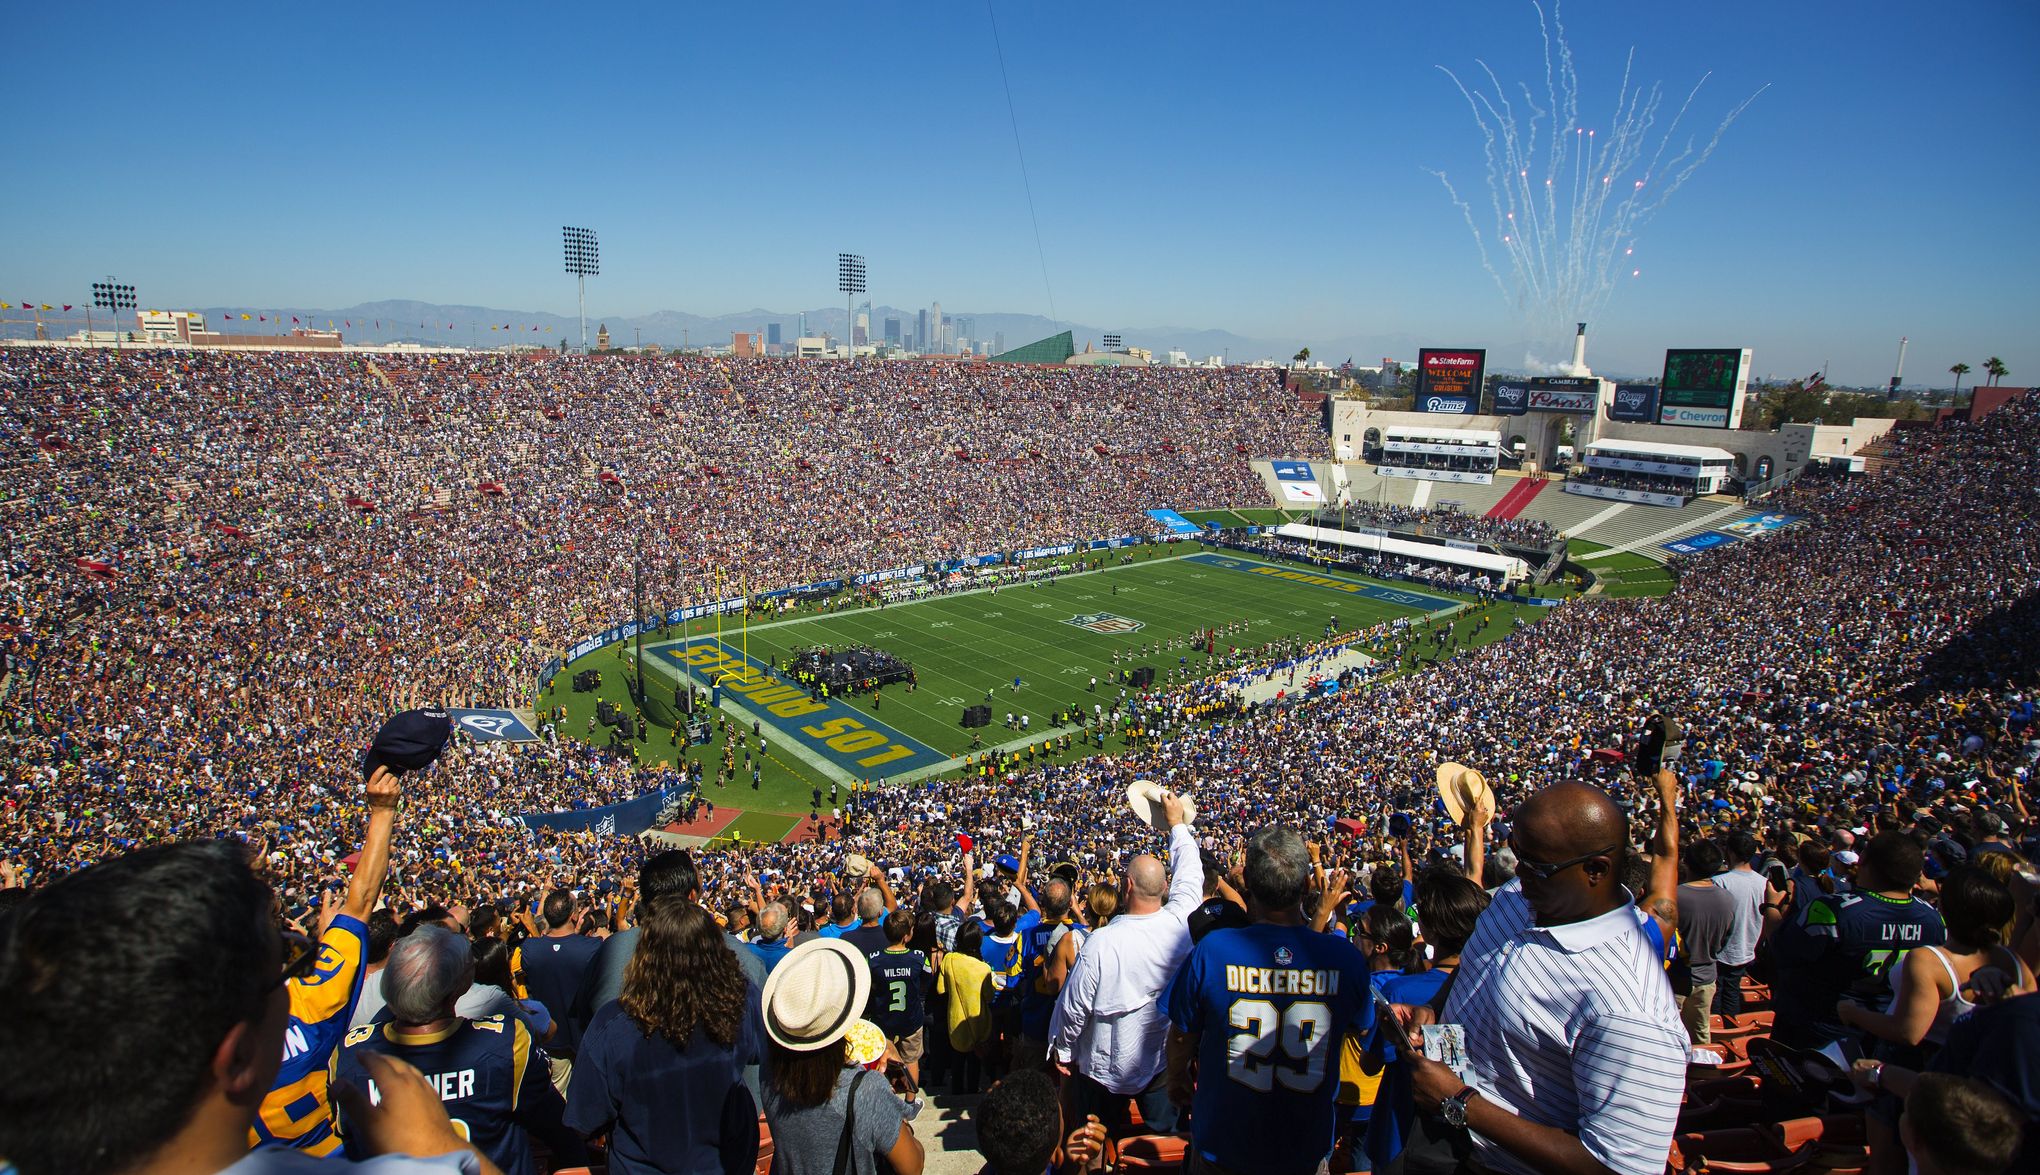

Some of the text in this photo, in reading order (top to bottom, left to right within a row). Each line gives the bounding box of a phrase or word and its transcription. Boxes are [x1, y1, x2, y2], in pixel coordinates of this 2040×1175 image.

[1427, 397, 1467, 413] Rams
[1680, 411, 1726, 422] Chevron
[1248, 567, 1368, 592] RAMS
[884, 968, 911, 978] WILSON
[1226, 965, 1341, 996] DICKERSON
[889, 981, 907, 1012] 3
[1227, 998, 1333, 1093] 29
